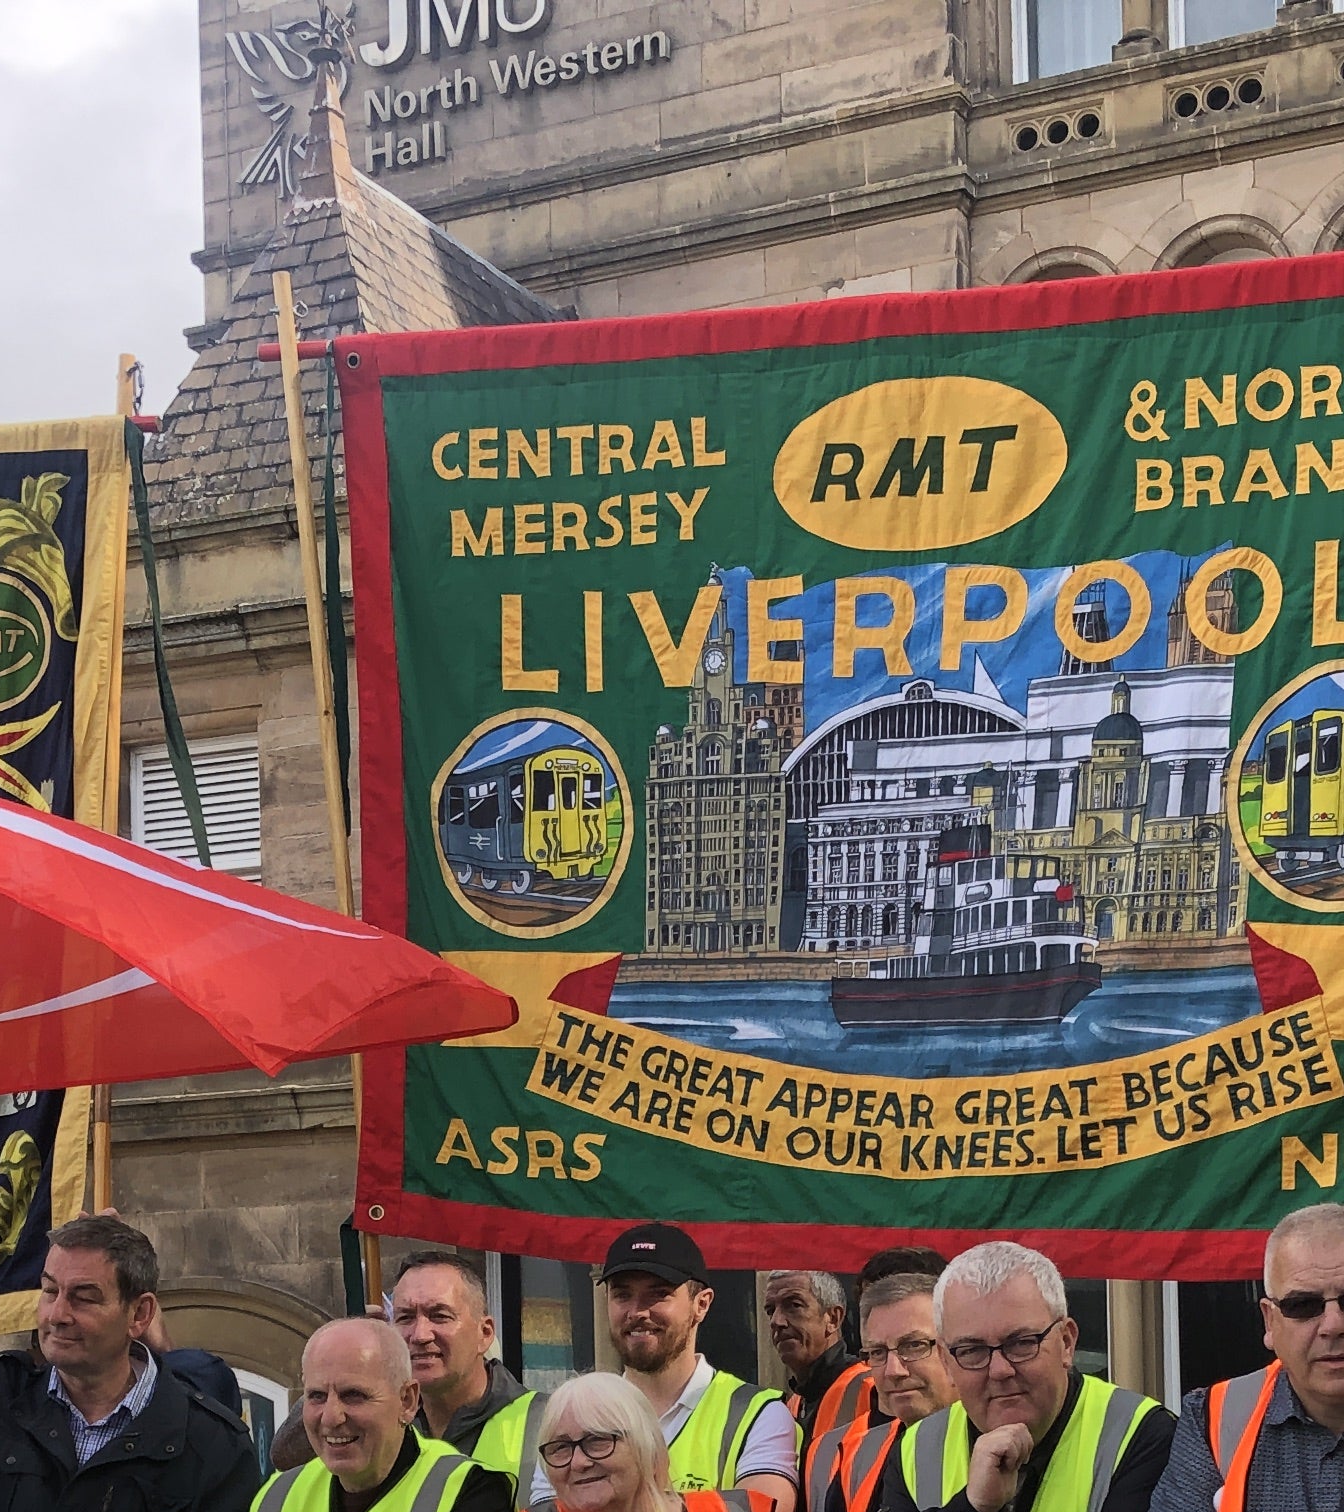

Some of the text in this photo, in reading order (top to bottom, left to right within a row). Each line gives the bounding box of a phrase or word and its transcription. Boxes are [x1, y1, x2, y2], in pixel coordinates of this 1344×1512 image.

[362, 28, 670, 126] North Western
[362, 119, 447, 174] Hall
[1125, 379, 1170, 442] &
[432, 416, 727, 481] CENTRAL
[810, 425, 1017, 503] RMT
[449, 486, 711, 558] MERSEY
[557, 1011, 1318, 1130] THE GREAT APPEAR GREAT BECAUSE
[541, 1052, 1333, 1173] WE ARE ON OUR KNEES. LET US RISE
[436, 1118, 608, 1182] ASRS
